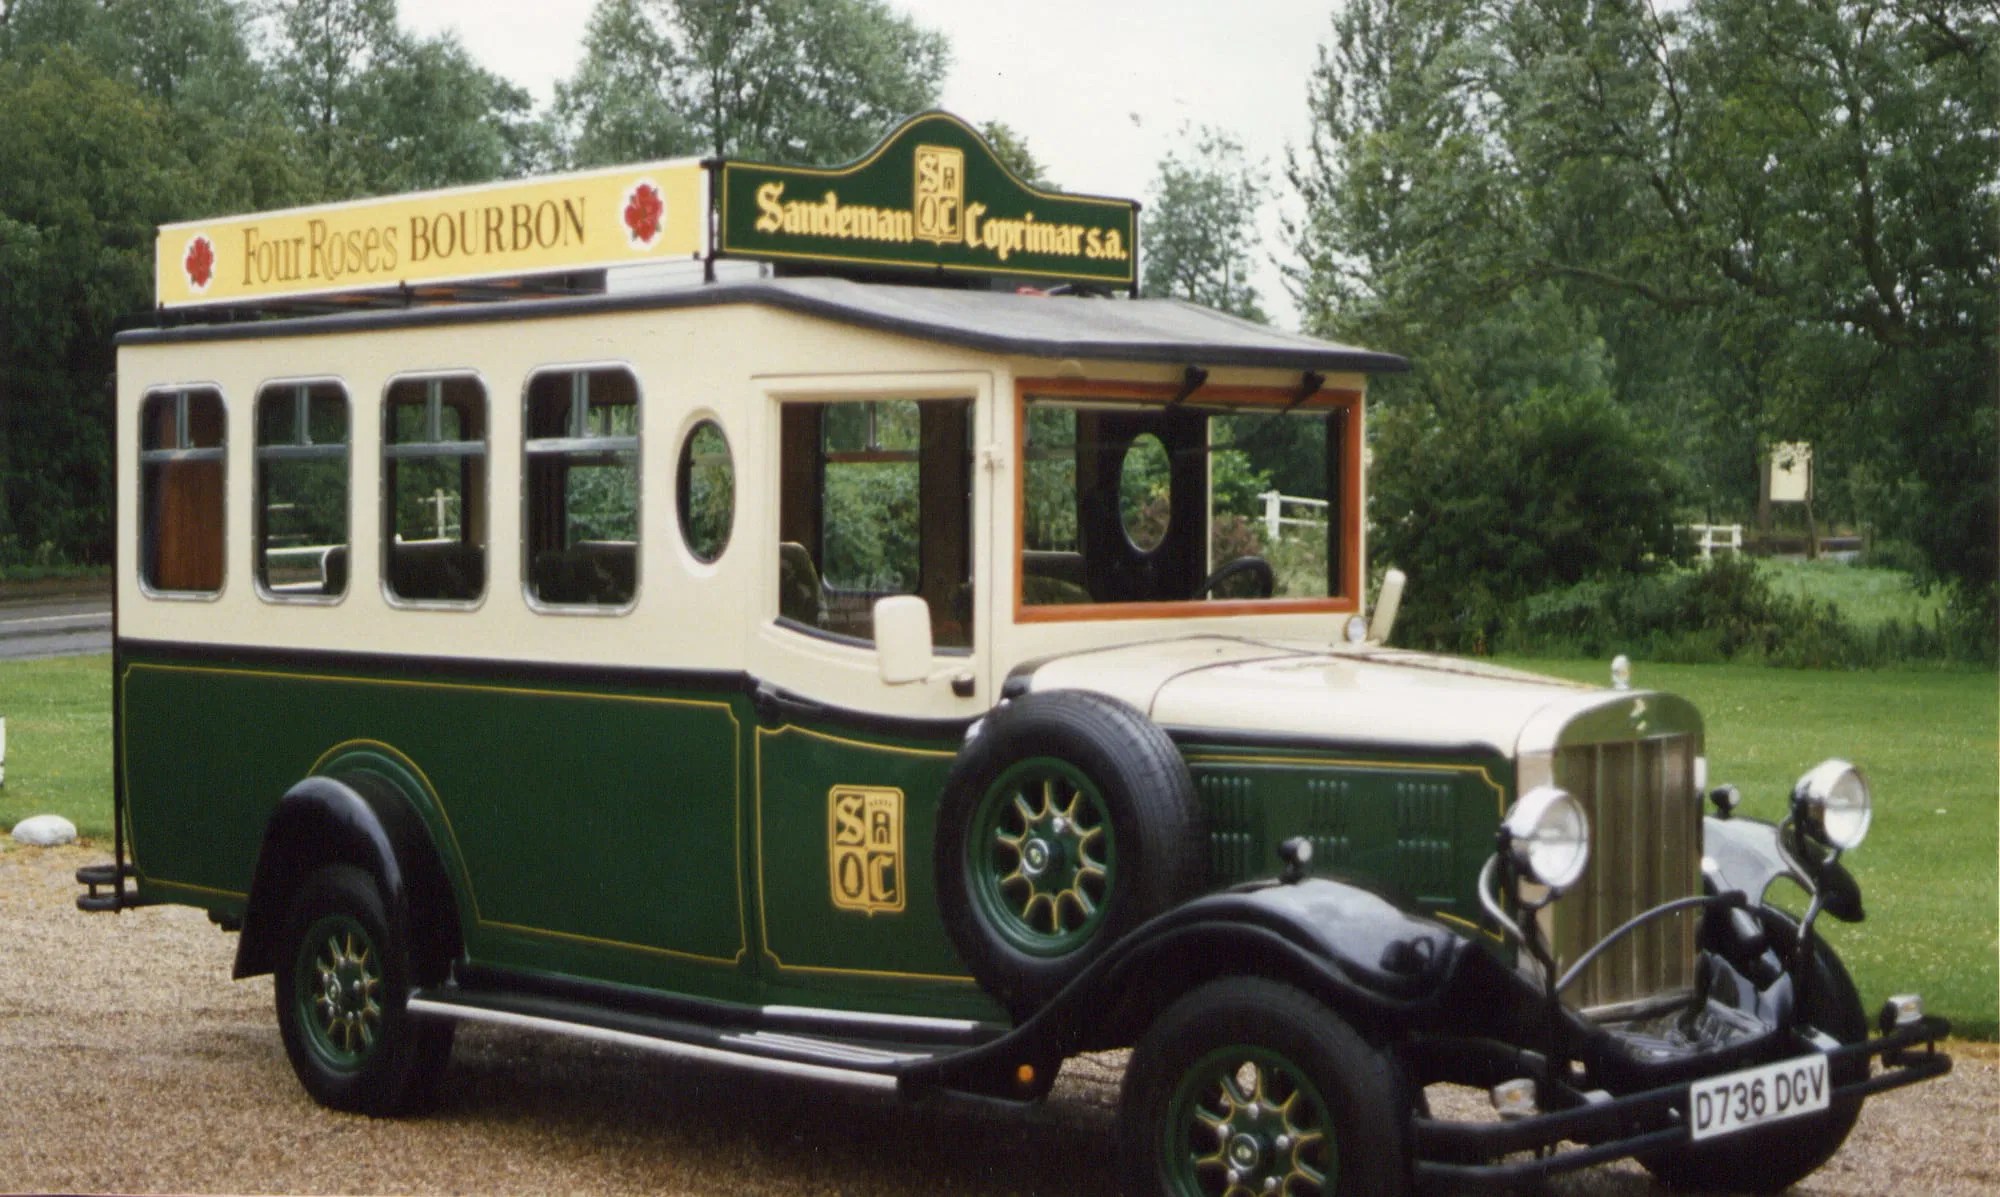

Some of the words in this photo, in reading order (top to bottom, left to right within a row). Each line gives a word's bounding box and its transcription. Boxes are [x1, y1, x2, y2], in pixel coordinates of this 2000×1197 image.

[242, 226, 304, 285] Four
[307, 218, 398, 281] Roses
[410, 197, 585, 262] BOURBON
[755, 181, 913, 242] Sandeman
[965, 203, 1084, 260] Coprimar
[1086, 227, 1128, 260] s.a.
[1697, 1078, 1766, 1131] D736
[1775, 1063, 1824, 1112] DGV
